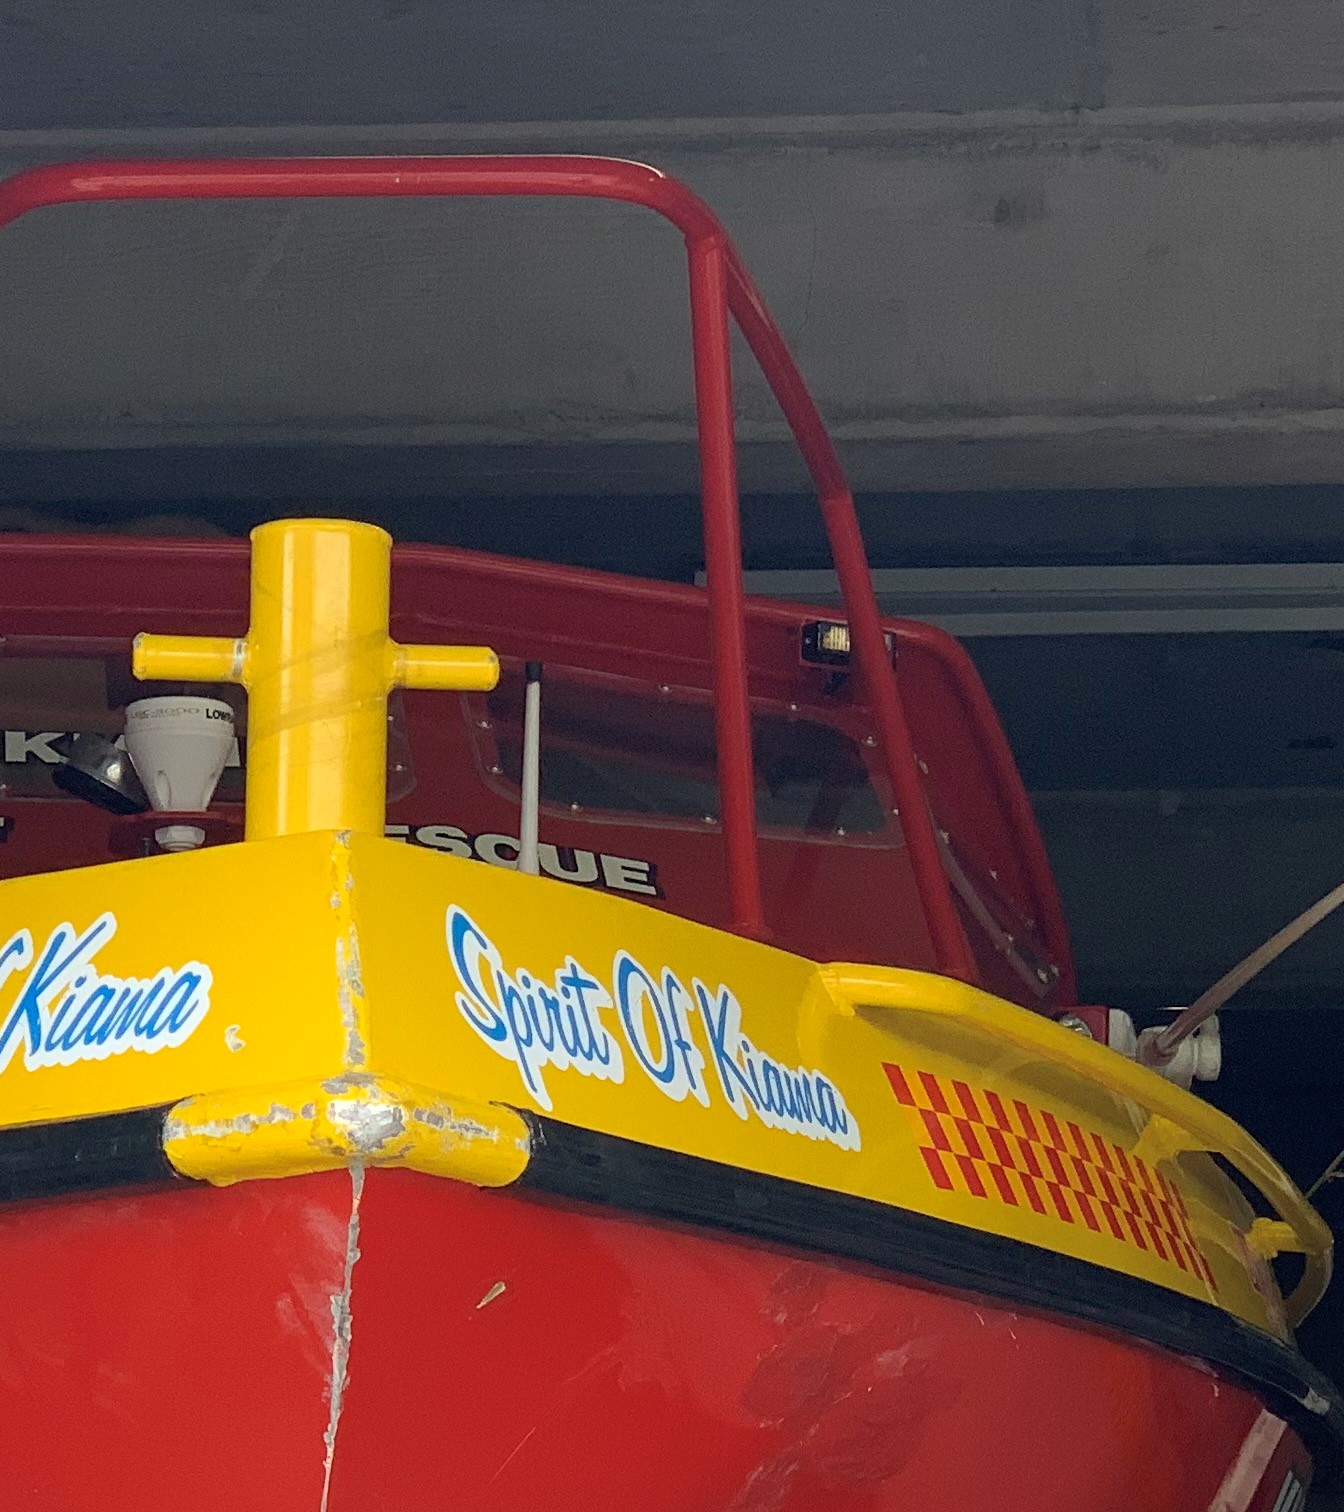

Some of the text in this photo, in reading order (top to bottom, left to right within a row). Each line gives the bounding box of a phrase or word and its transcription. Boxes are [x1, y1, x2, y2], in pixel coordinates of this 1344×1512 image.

[449, 906, 856, 1146] Spirit Of Kiama
